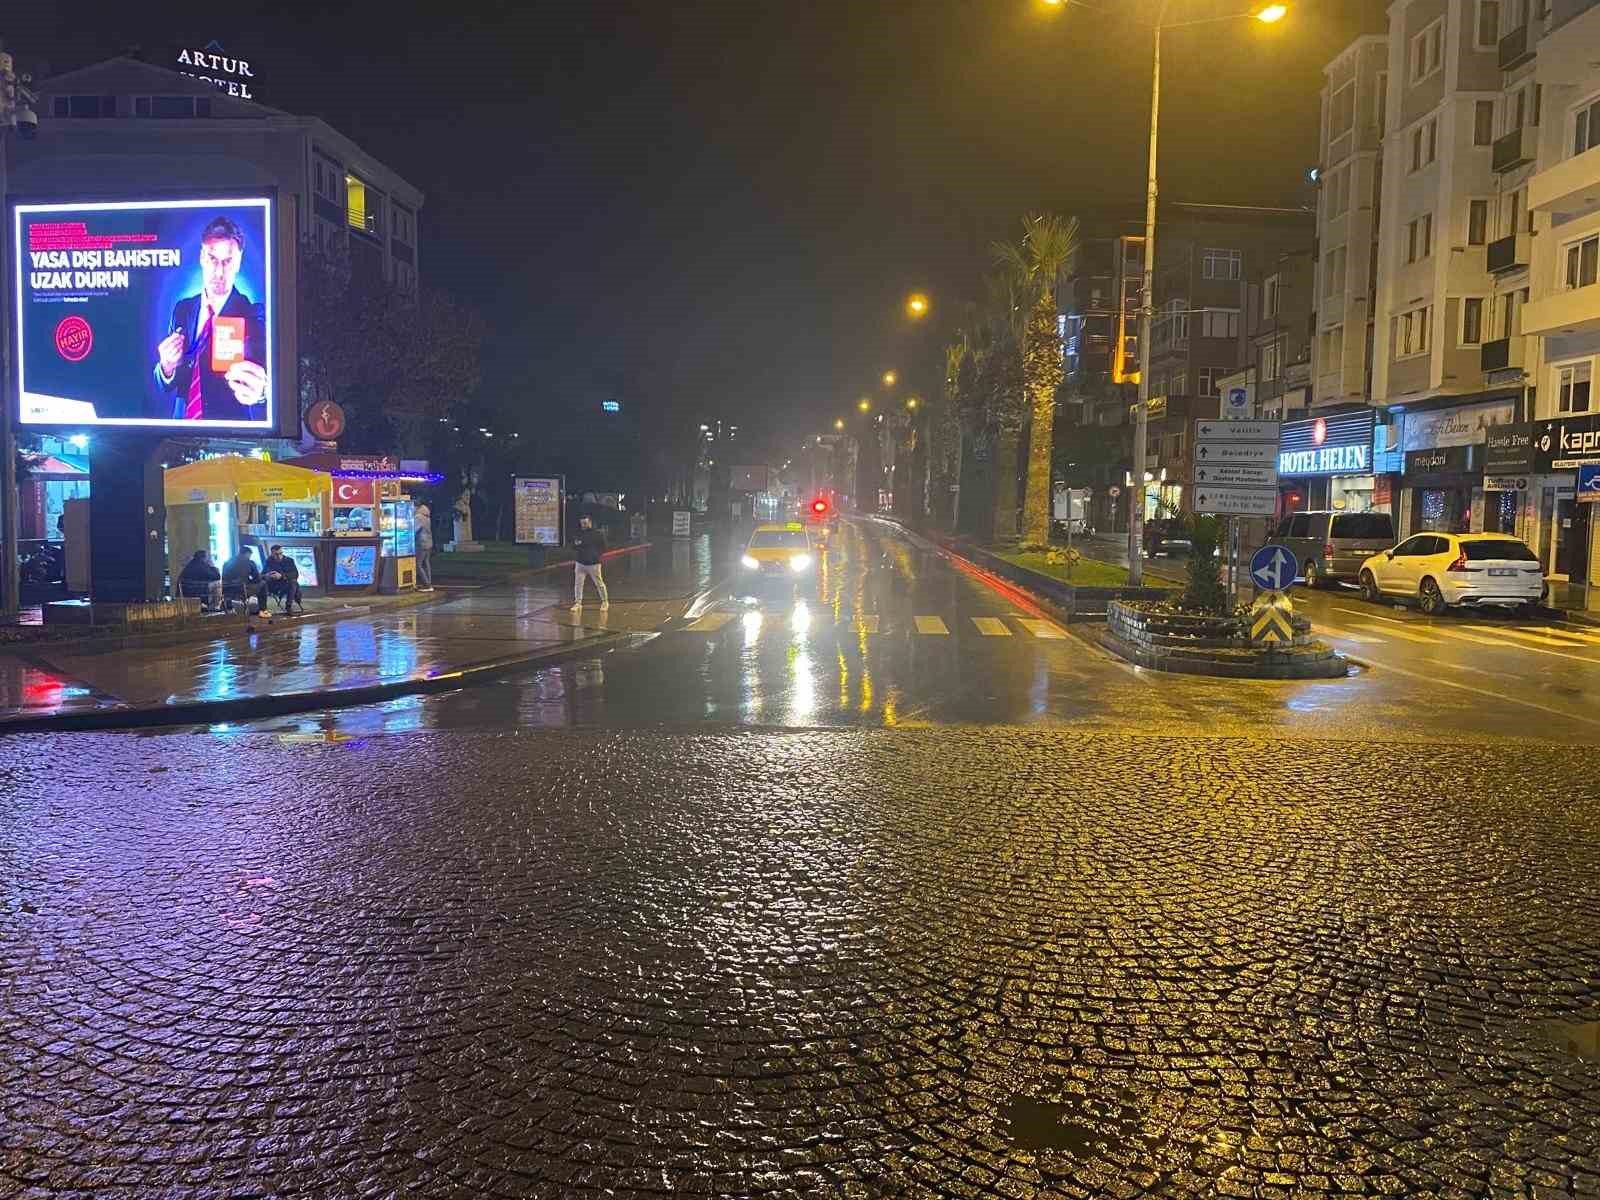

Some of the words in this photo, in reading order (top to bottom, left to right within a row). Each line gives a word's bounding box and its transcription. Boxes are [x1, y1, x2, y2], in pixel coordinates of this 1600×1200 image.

[177, 49, 254, 77] ARTUR
[179, 71, 252, 99] TEL
[30, 251, 70, 268] YASA
[72, 251, 101, 270] DIŞI
[104, 249, 180, 268] BAHİSTEN
[31, 271, 72, 289] UZAK
[75, 270, 129, 288] DURUN
[60, 329, 89, 349] HAYIR
[1511, 433, 1530, 446] Free
[1280, 451, 1317, 473] HOTEL
[1320, 445, 1368, 471] HELEN
